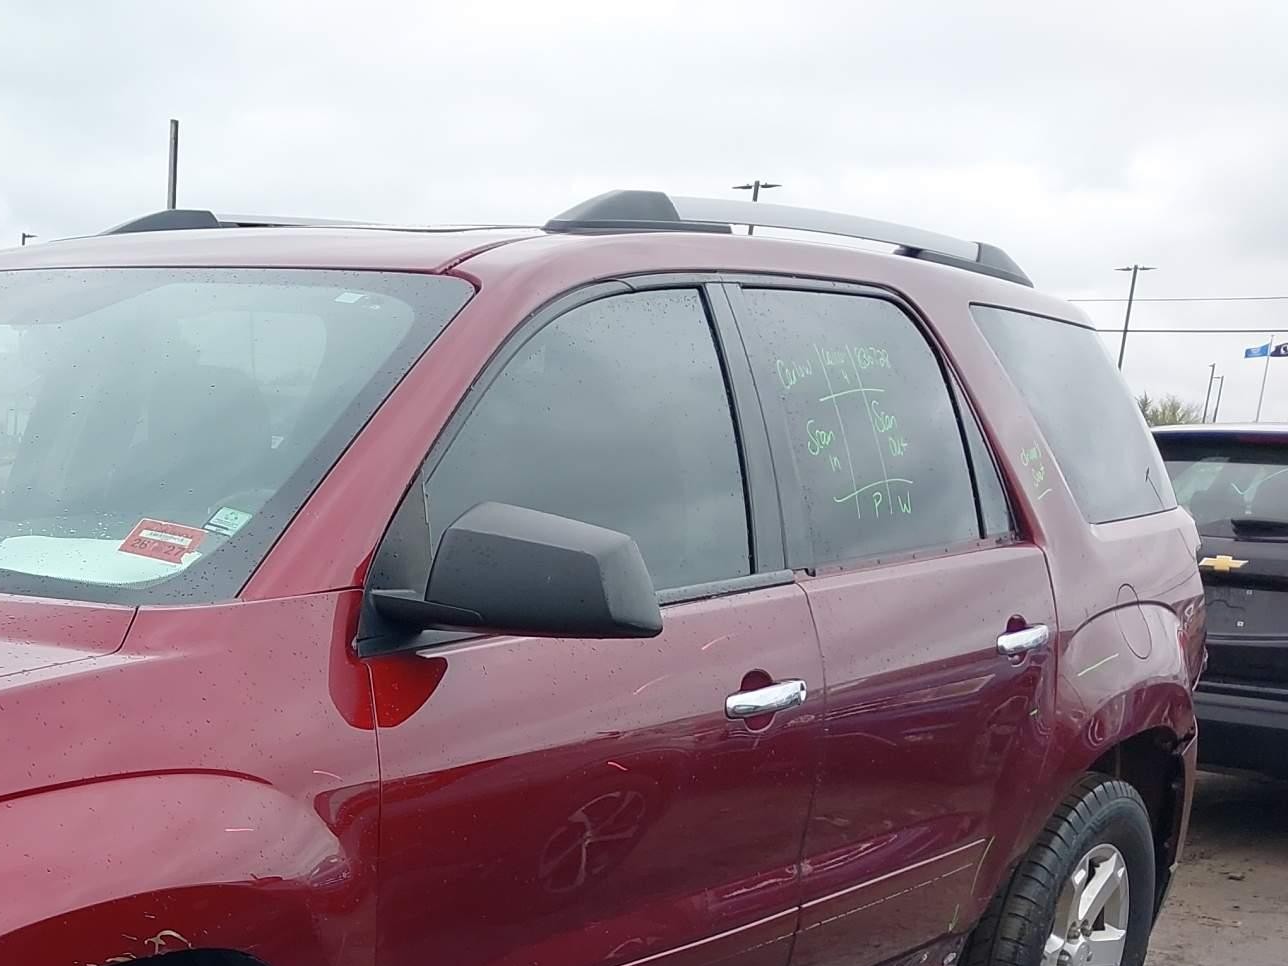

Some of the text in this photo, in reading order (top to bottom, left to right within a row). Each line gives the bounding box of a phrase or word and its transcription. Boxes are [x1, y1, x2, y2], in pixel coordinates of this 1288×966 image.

[872, 490, 912, 519] P W
[163, 544, 186, 557] 27
